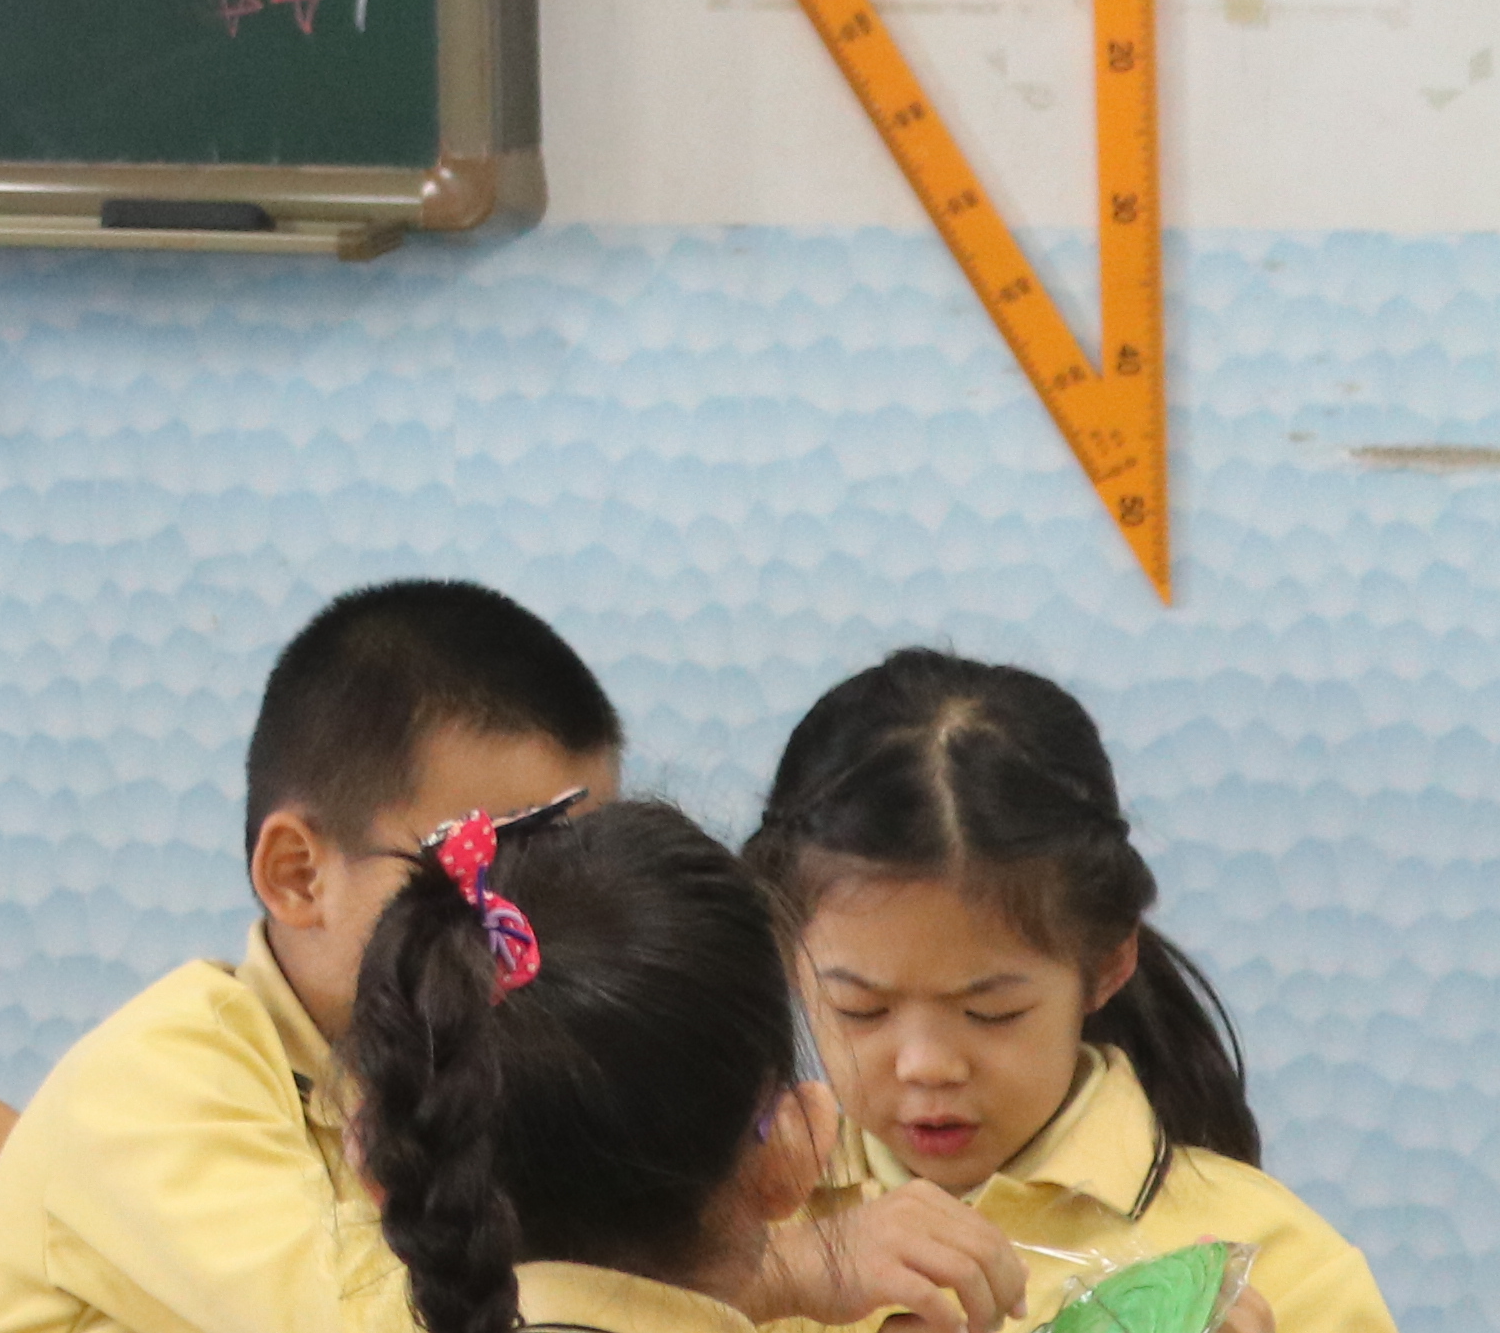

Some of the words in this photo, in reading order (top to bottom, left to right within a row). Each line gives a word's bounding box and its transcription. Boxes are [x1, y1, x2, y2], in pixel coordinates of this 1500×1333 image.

[1108, 39, 1136, 73] 20
[1111, 192, 1138, 225] 30
[1116, 343, 1143, 376] 40
[1119, 494, 1146, 527] 50
